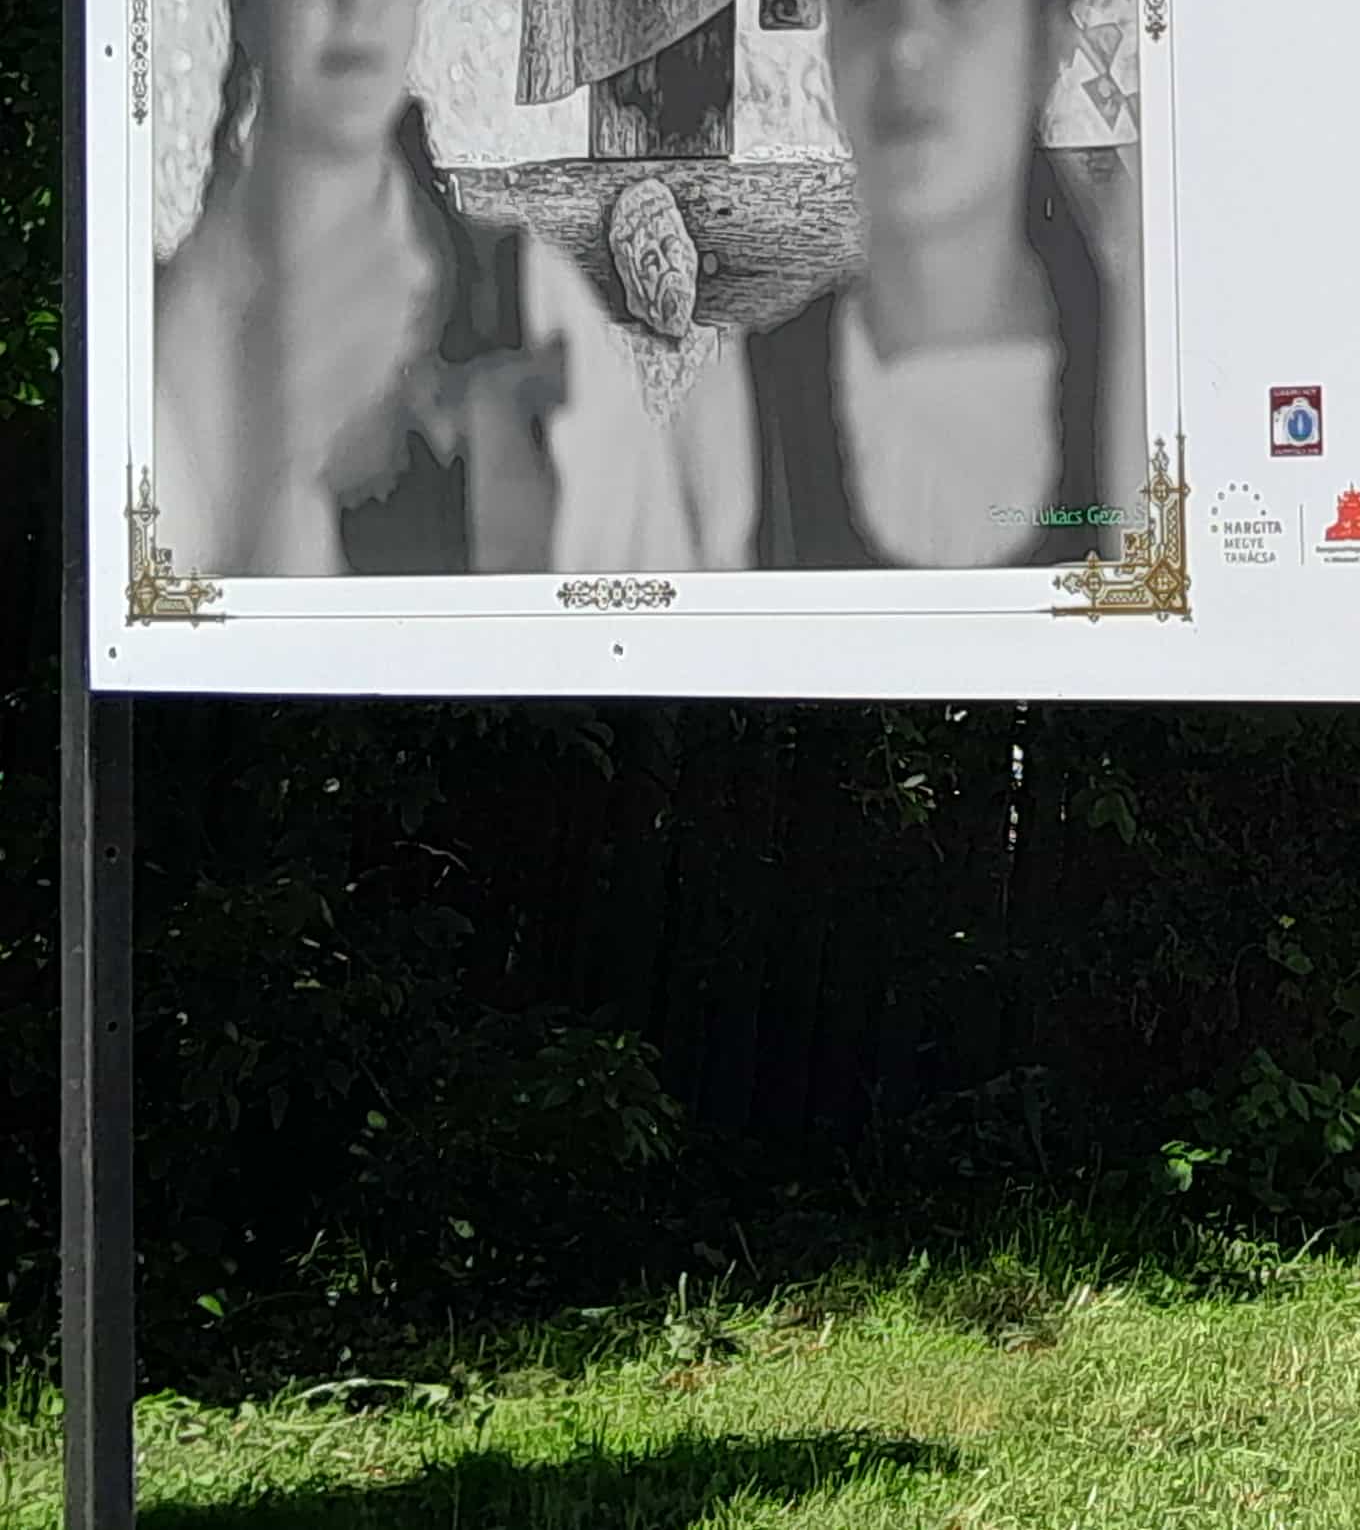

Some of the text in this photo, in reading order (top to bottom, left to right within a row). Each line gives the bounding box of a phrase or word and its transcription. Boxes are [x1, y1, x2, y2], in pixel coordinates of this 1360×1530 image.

[1032, 504, 1083, 526] Lukács
[1224, 520, 1283, 535] HARGITA
[1224, 538, 1265, 549] MEGYE
[1224, 551, 1277, 565] TANÁCSA
